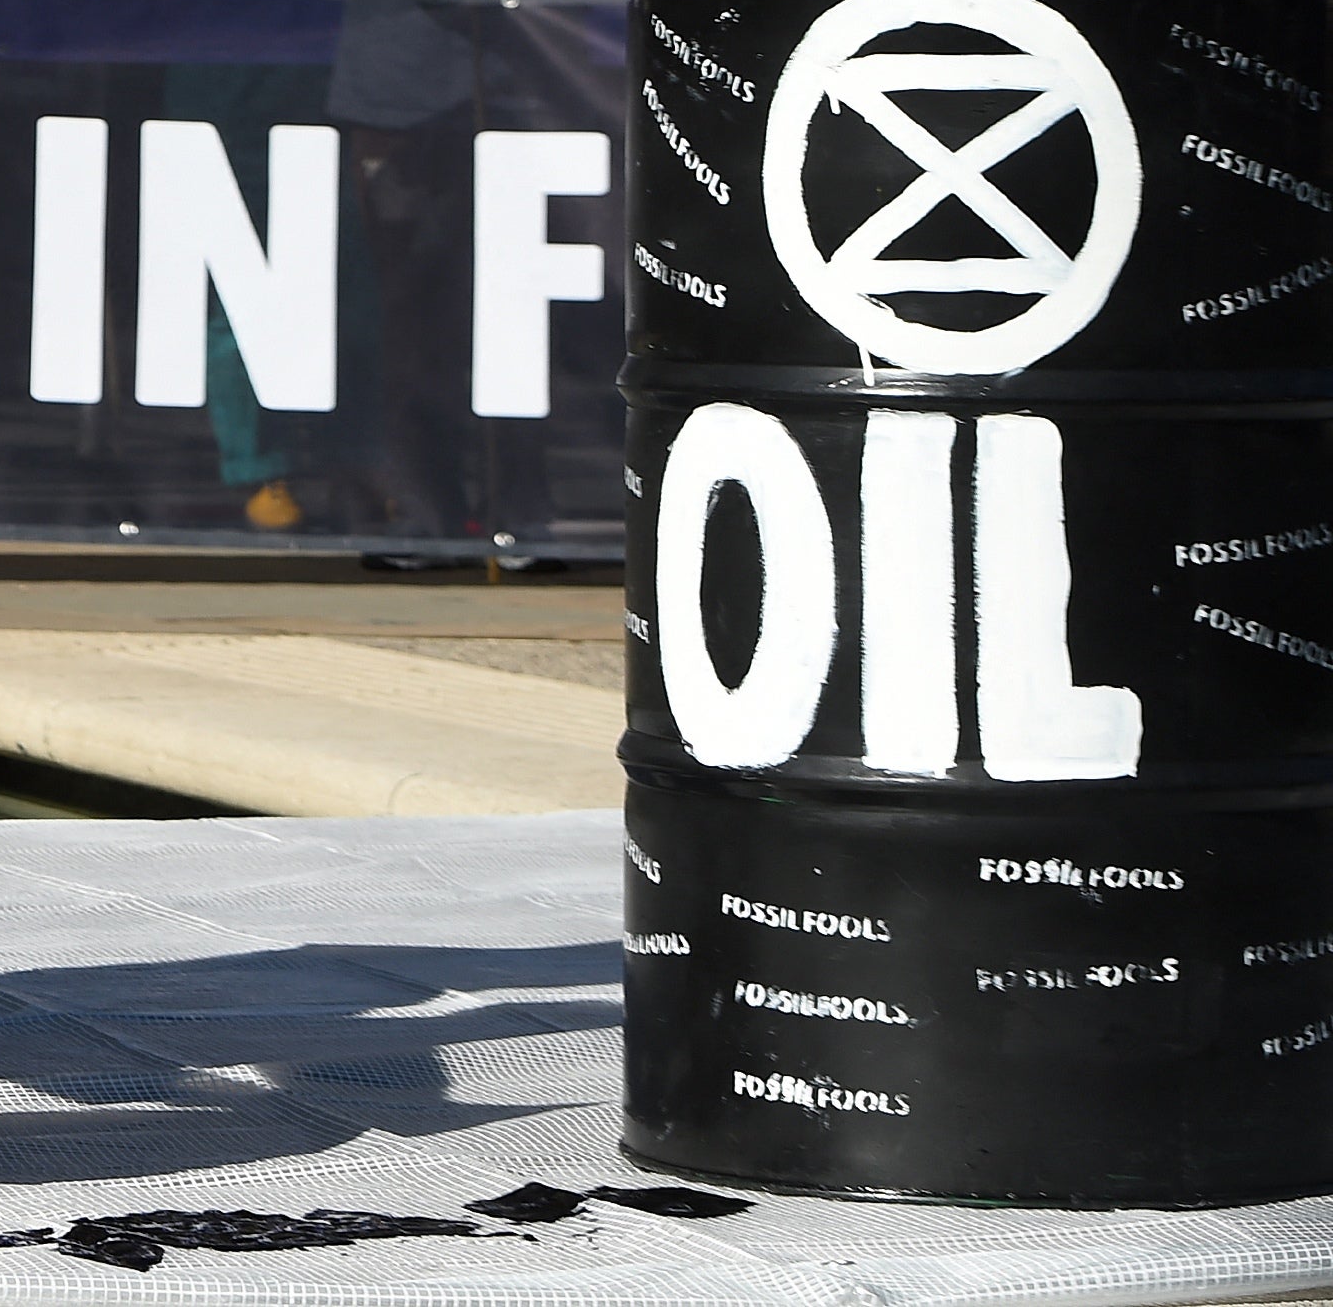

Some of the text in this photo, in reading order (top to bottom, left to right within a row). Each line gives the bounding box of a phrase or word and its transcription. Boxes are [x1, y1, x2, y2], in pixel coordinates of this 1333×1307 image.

[1182, 134, 1264, 184] FOSSIL
[29, 114, 340, 413] IN
[1182, 286, 1270, 323] FOSSIL
[1175, 539, 1265, 568] FOSSIL
[656, 401, 1143, 783] OIL
[1194, 603, 1275, 649] FOSSIL
[979, 857, 1184, 889] FOSSIL FOOLS
[722, 893, 892, 943] FOSSIL FOOLS
[733, 1070, 911, 1116] FOSSIL FOOLS
